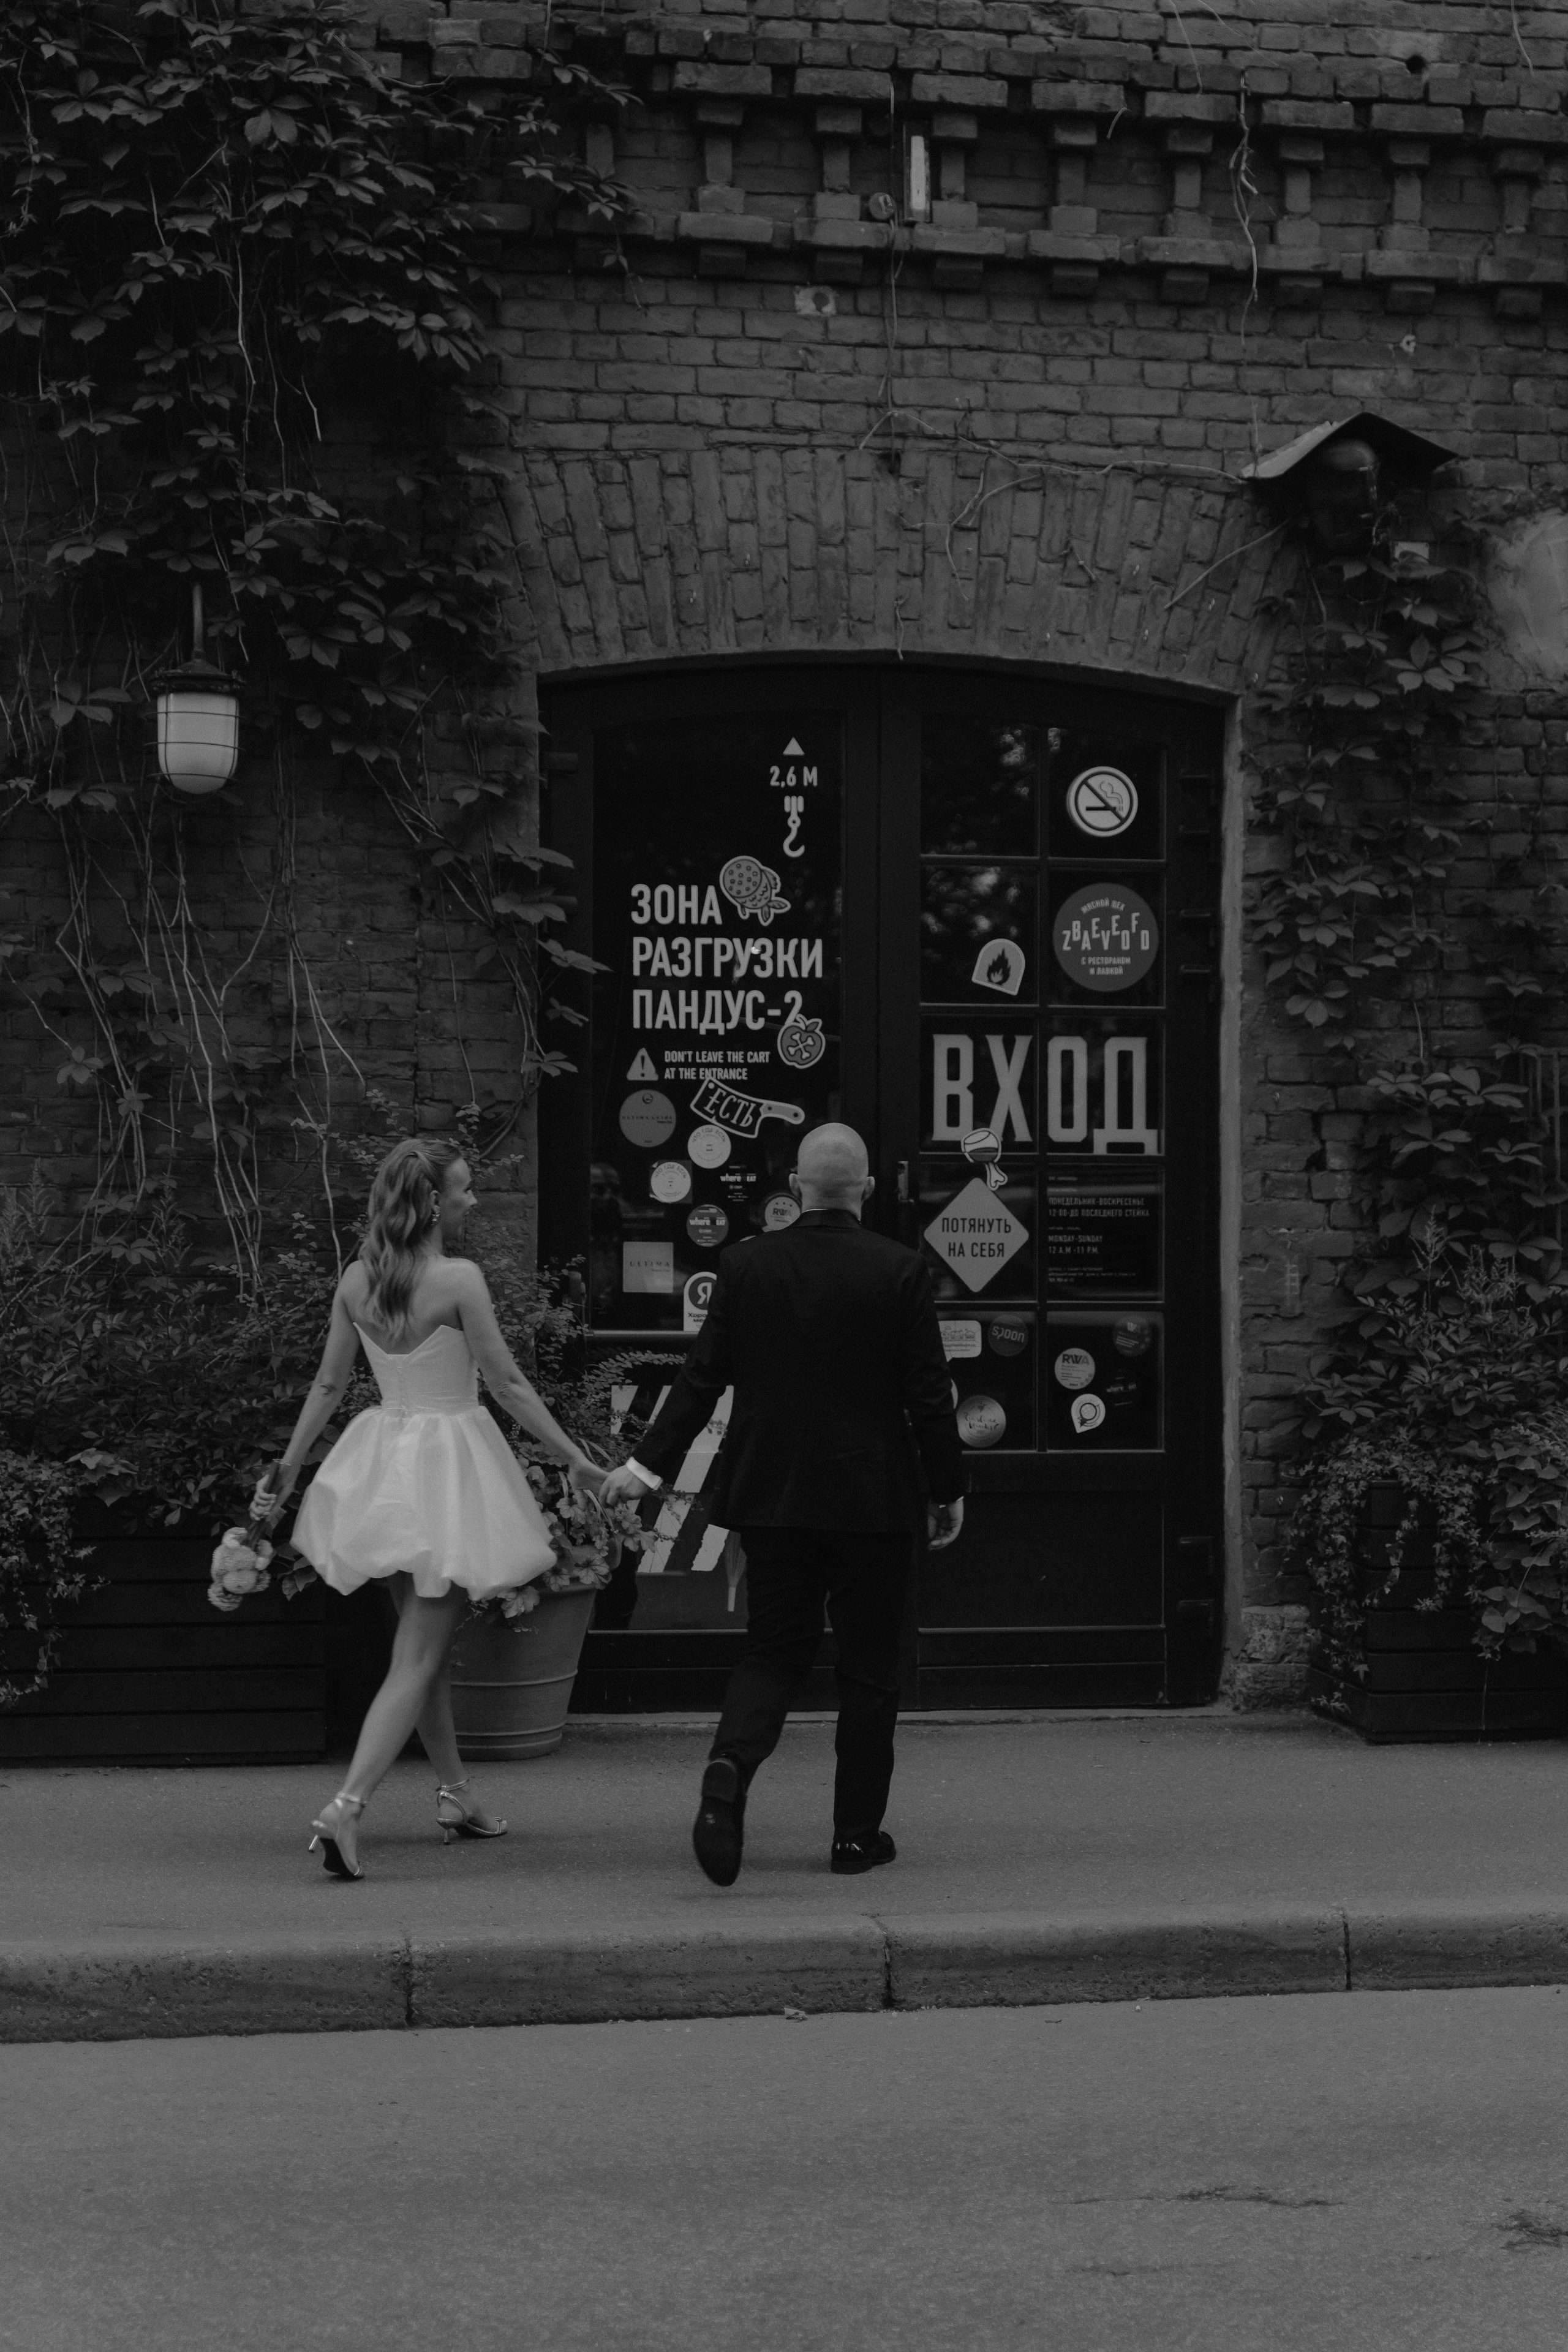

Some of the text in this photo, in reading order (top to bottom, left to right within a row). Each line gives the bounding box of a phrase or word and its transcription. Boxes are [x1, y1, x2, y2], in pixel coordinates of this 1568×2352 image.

[770, 766, 796, 788] 2,6
[631, 884, 722, 925] ЗОНА
[1080, 897, 1110, 914] МЯСНОЙ
[633, 937, 823, 978] РАЗГРУЗКИ
[1096, 965, 1123, 975] ЛАВКОЙ
[633, 989, 803, 1035] ПАНДУС-2
[665, 1050, 771, 1063] DON'T LEAVE THE CART
[664, 1068, 748, 1080] AT THE ENTRANCE
[932, 1033, 1158, 1155] ВХОД
[703, 1087, 756, 1127] ЕСТЬ
[1081, 1208, 1123, 1217] ПОСЛЕДНЕГО
[1125, 1207, 1150, 1217] СТЕЙКА
[942, 1218, 1011, 1233] ПОТЯНУТЬ
[949, 1242, 1005, 1257] НА СЕБЯ
[697, 1281, 712, 1305] Я
